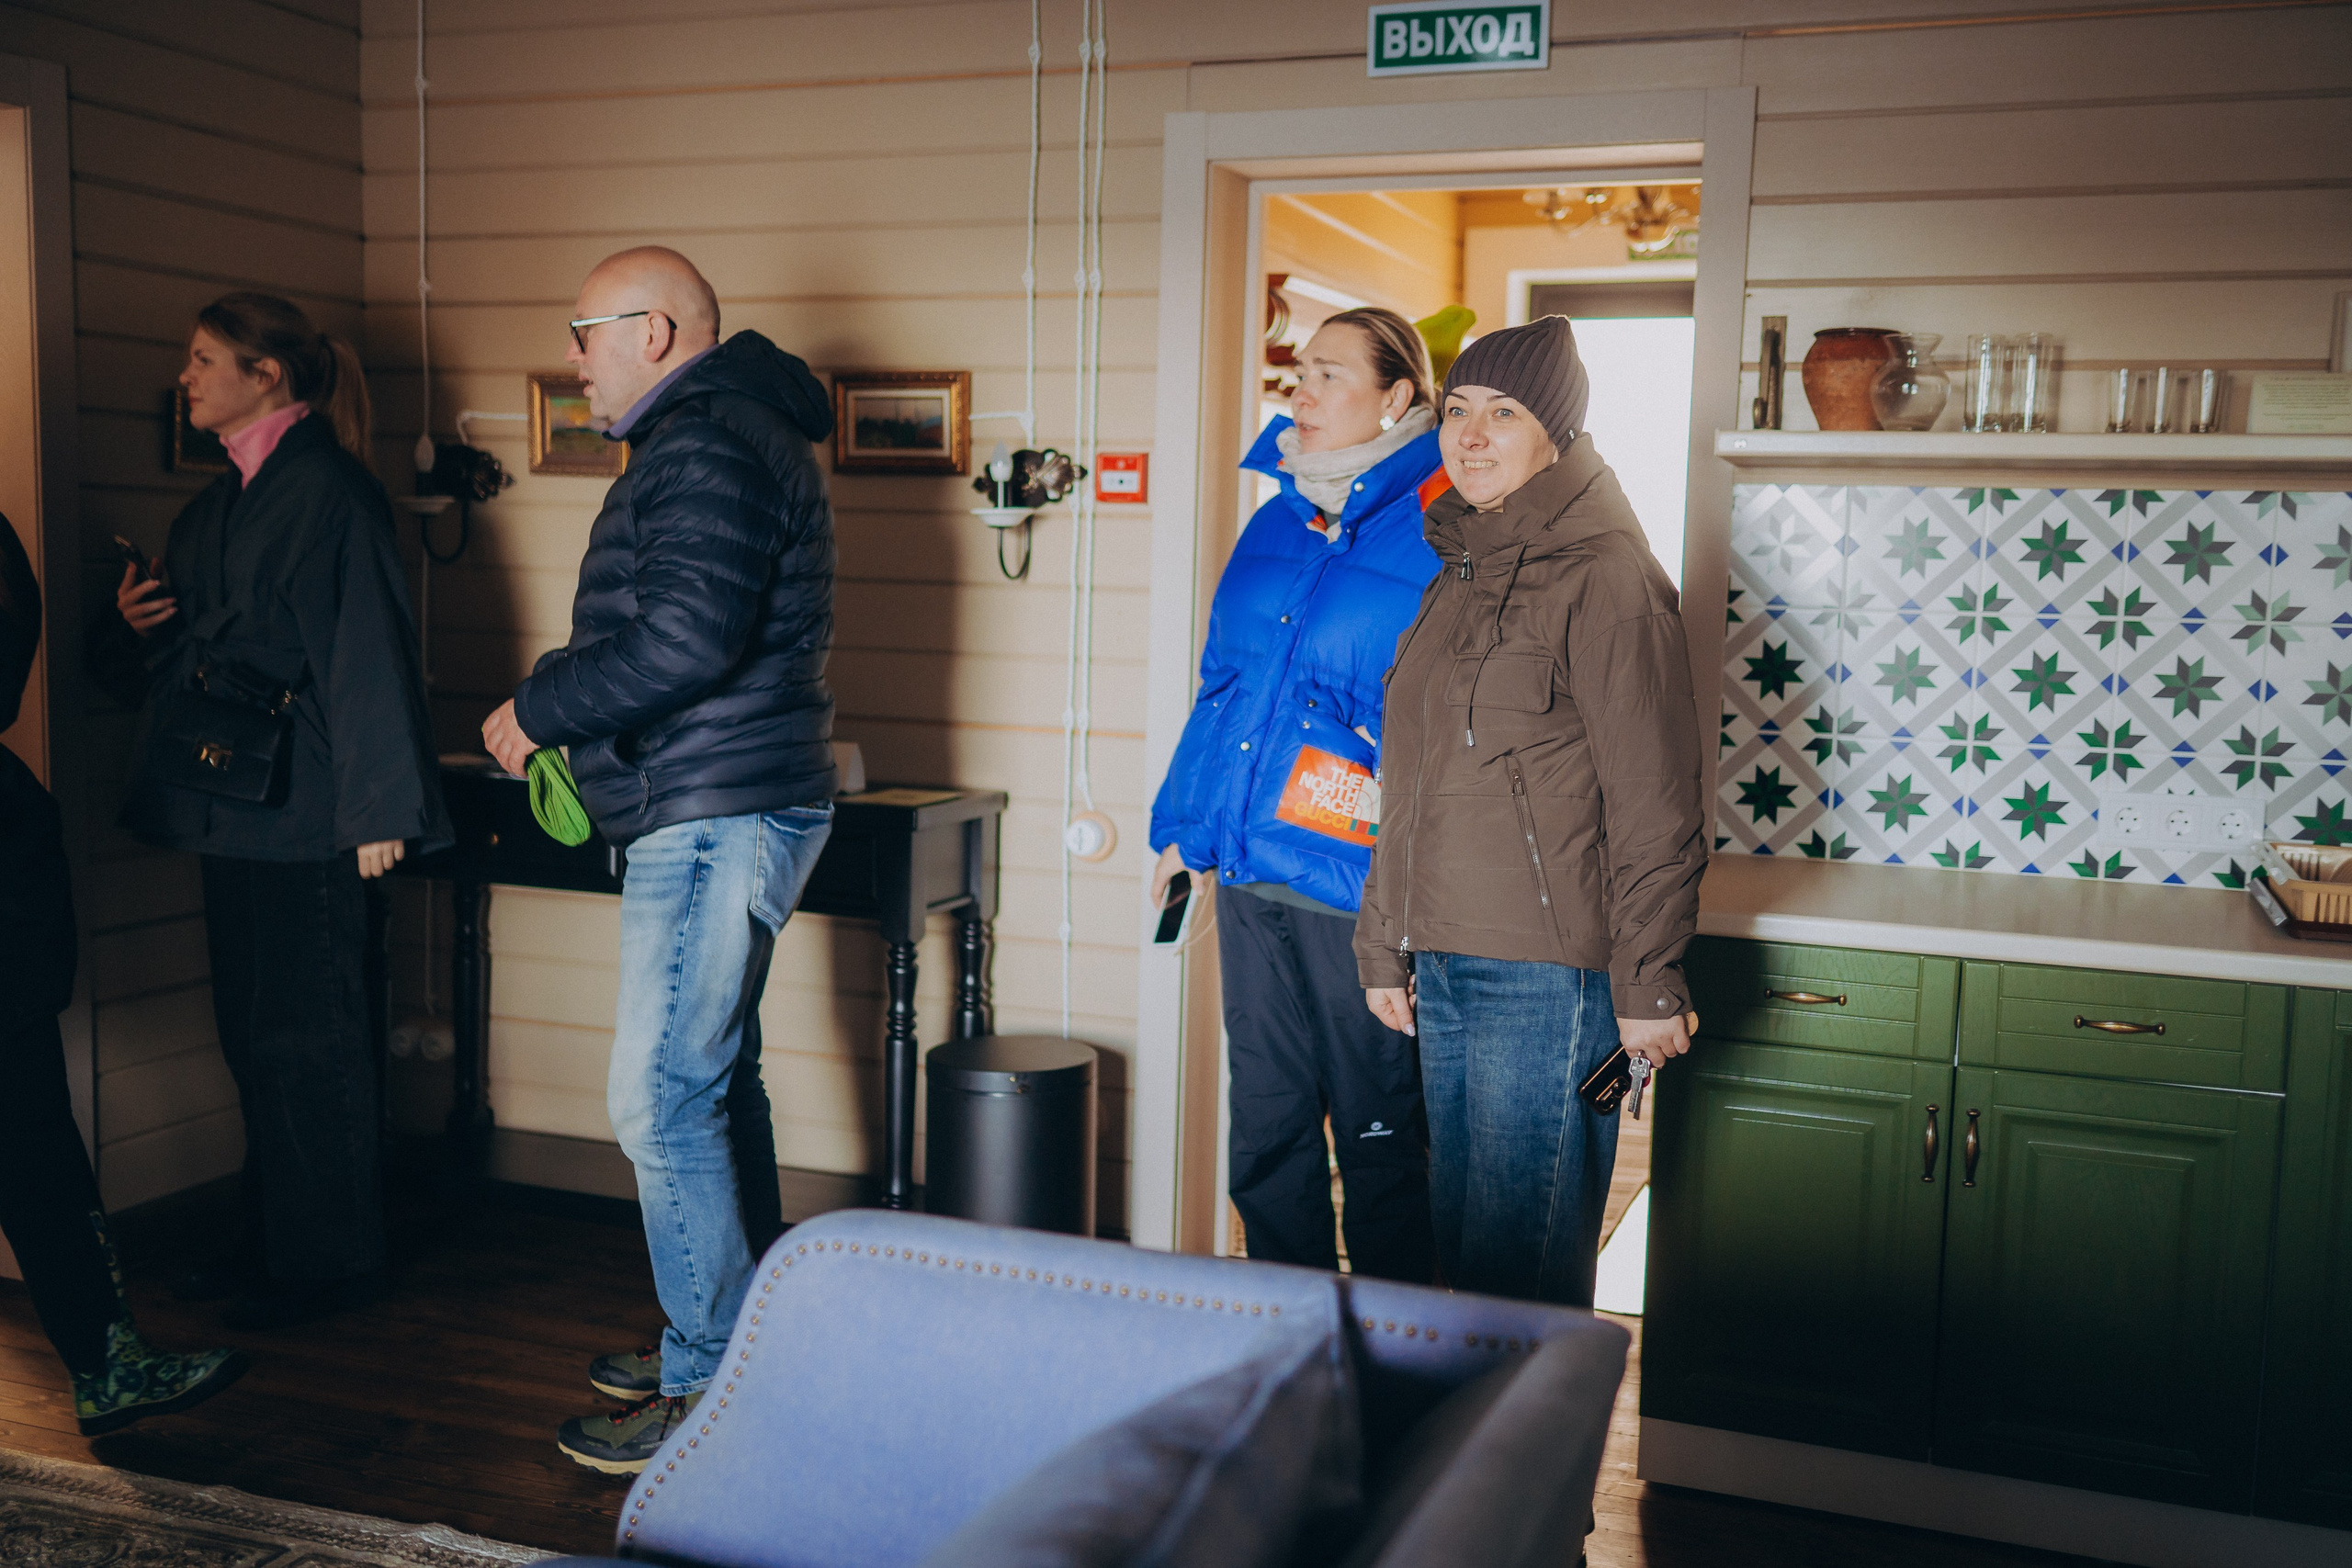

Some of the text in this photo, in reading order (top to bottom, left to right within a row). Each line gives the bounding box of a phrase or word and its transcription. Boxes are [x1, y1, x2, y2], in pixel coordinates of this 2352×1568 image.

[1383, 13, 1535, 59] ВЫХОД
[1298, 771, 1359, 803] NORTH
[1331, 766, 1363, 790] THE
[1294, 801, 1350, 831] GUCCI
[1310, 790, 1354, 818] FACE
